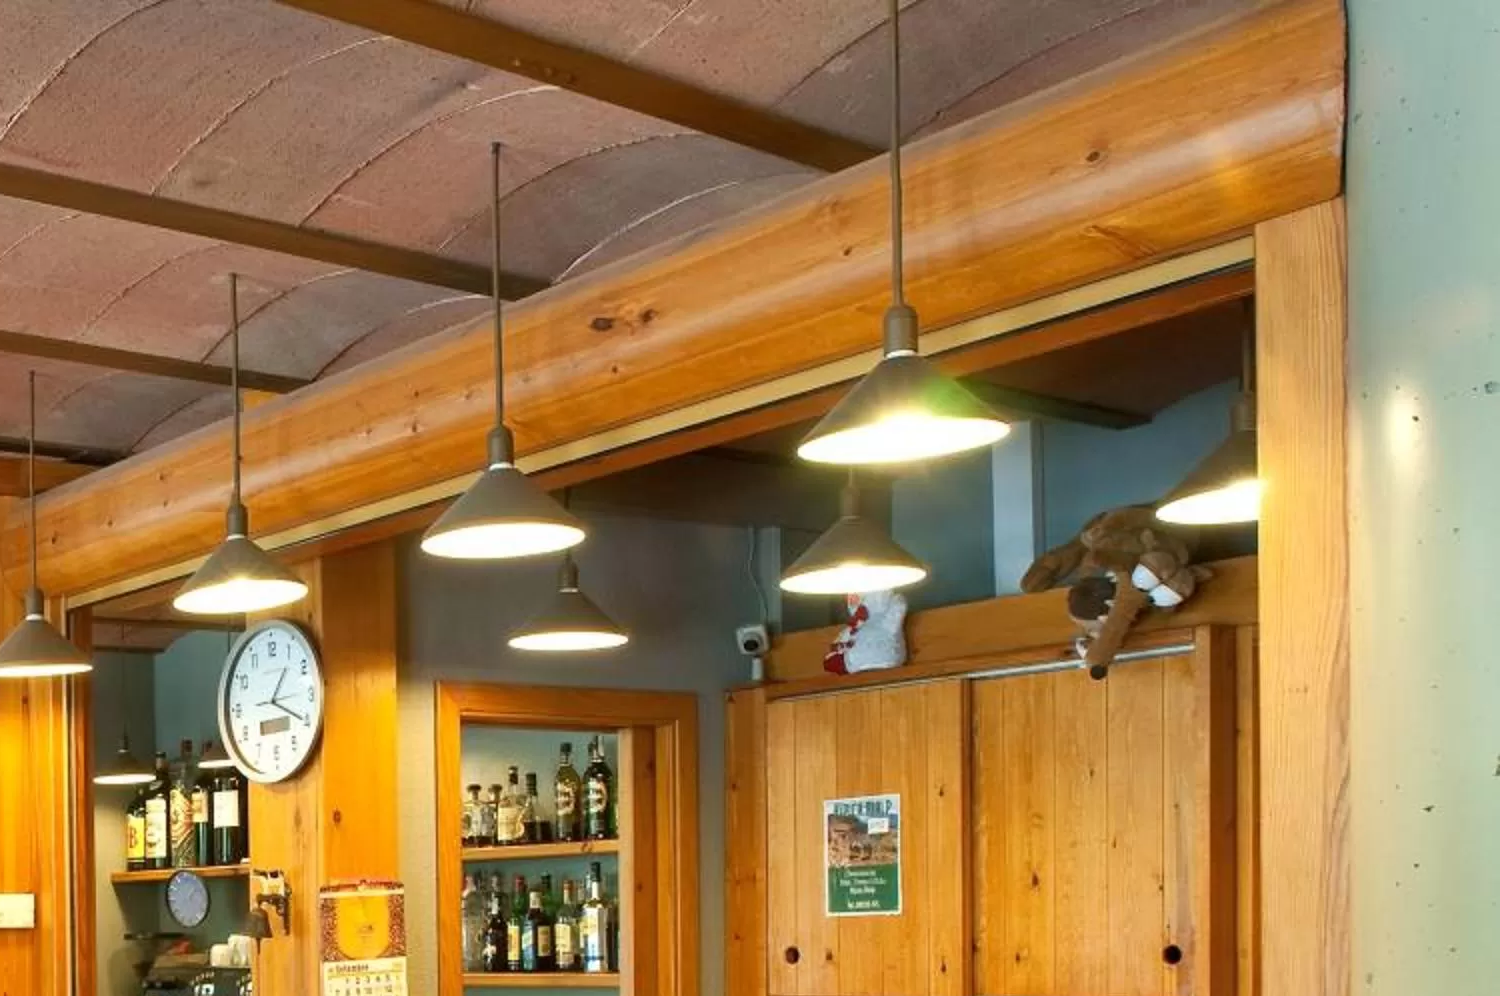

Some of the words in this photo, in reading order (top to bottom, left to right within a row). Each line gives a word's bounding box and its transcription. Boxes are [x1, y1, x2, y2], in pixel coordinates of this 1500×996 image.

[268, 641, 277, 657] 12
[300, 659, 307, 675] 2
[308, 685, 314, 702] 3
